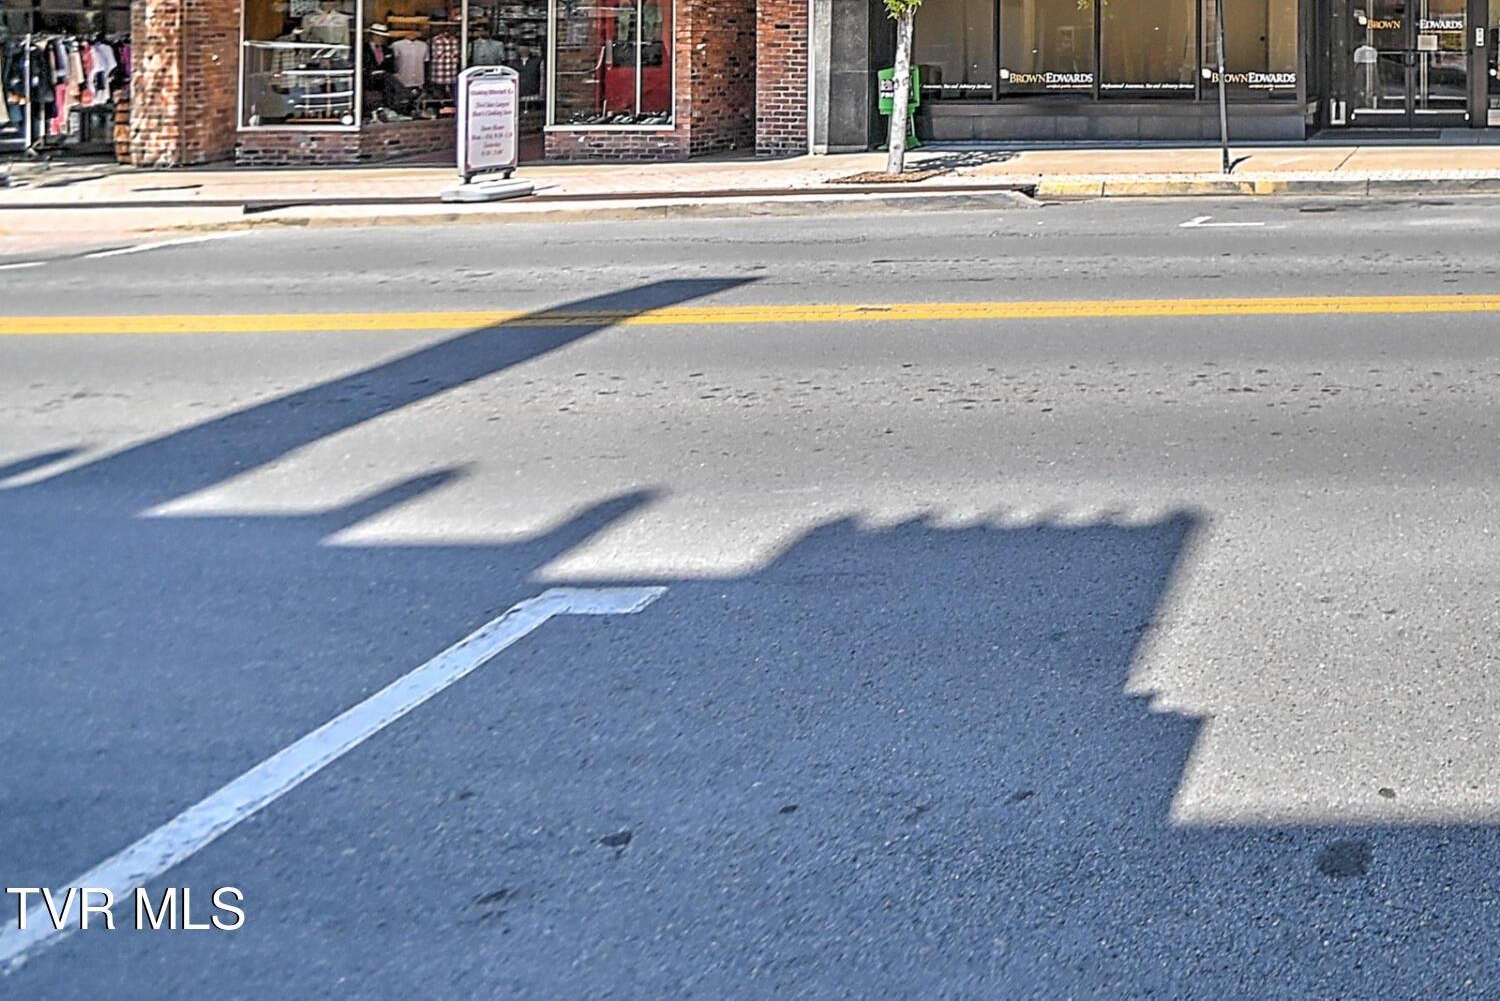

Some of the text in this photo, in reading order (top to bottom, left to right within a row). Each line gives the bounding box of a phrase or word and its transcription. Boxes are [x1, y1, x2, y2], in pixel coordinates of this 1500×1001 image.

[1367, 19, 1463, 30] BROWN EDWARDS
[1211, 72, 1296, 84] BOWNEDWARDS
